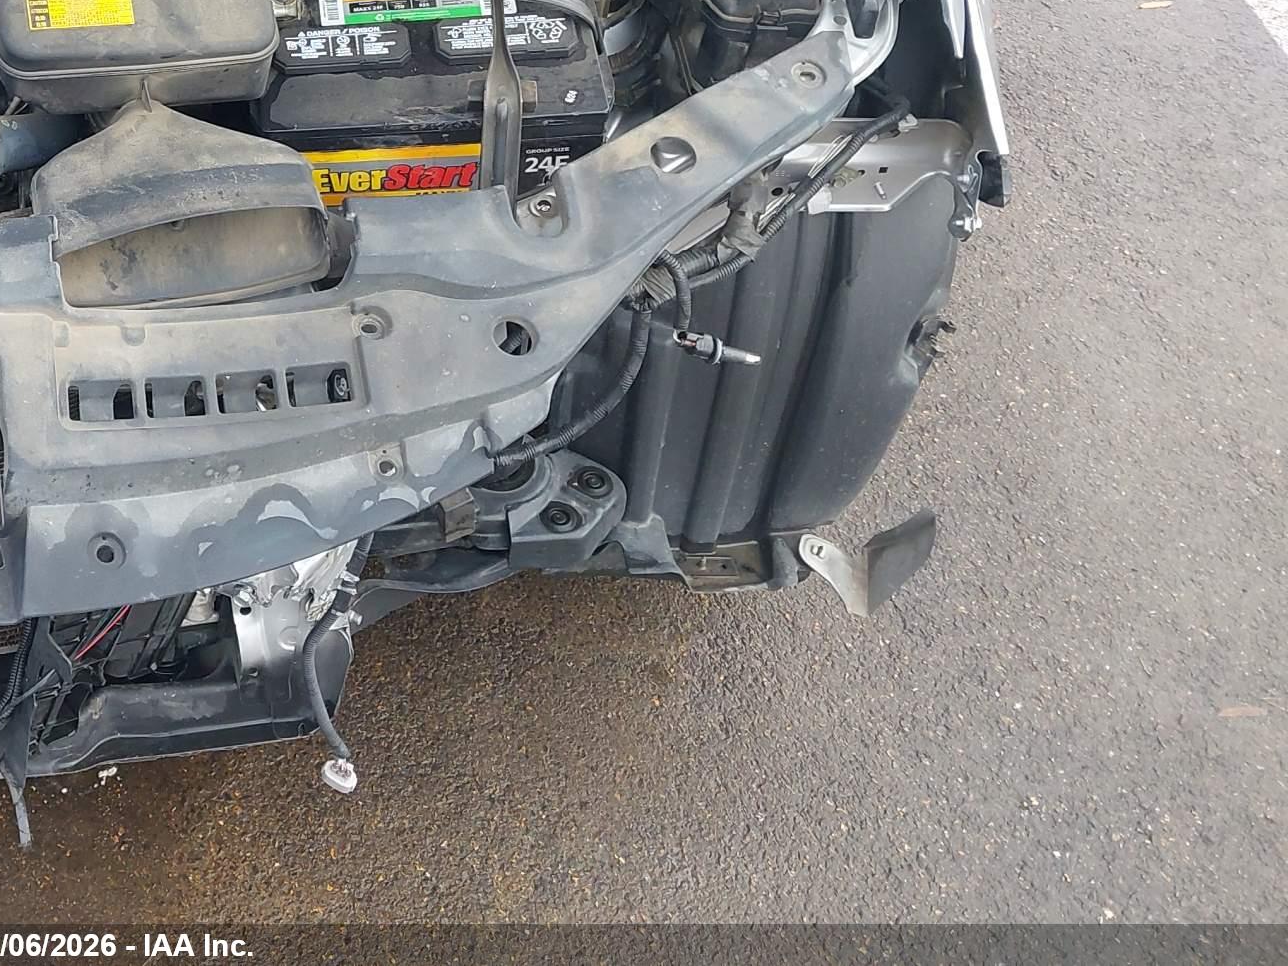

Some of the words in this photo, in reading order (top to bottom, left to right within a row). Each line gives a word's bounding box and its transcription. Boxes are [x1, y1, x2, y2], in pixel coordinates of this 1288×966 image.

[307, 29, 341, 37] DANGER
[349, 26, 380, 34] POISON
[312, 161, 479, 195] EverStart
